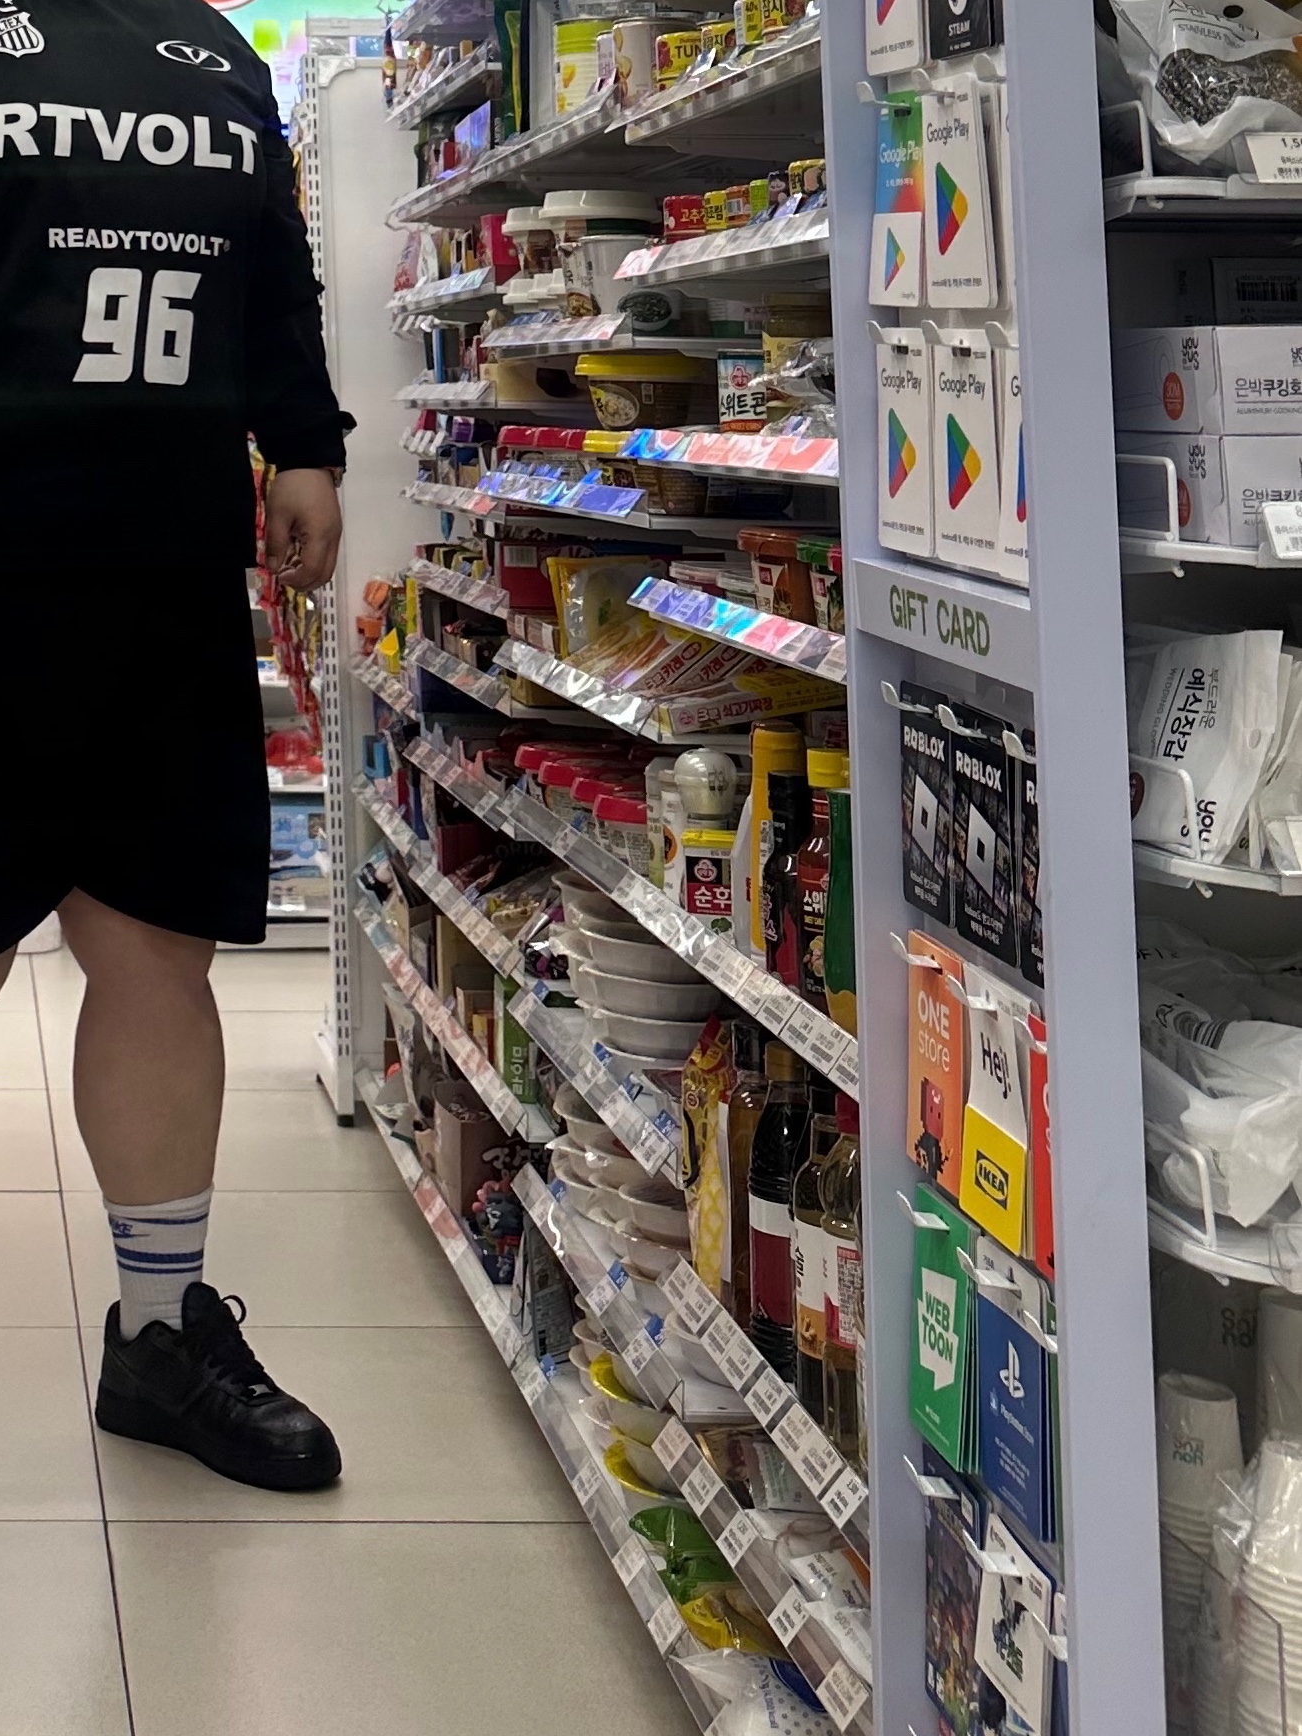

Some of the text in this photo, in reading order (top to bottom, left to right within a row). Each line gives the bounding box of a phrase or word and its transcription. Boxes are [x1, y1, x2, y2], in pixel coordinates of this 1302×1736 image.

[948, 19, 971, 37] STEAM
[927, 118, 970, 145] Google Play
[879, 141, 906, 167] Google
[72, 266, 202, 386] 96
[880, 367, 922, 395] Google Play
[938, 372, 986, 401] Google Play
[889, 584, 991, 657] GIFT CARD
[1163, 668, 1206, 762] 예식장갑
[903, 724, 946, 762] ROBLOX
[955, 750, 1003, 793] ROBLOX
[917, 990, 950, 1040] ONE
[917, 1029, 950, 1072] store
[980, 1031, 1012, 1100] Hej!
[977, 1162, 1006, 1197] IKEA
[925, 1290, 951, 1328] WEB
[922, 1317, 954, 1365] TOON
